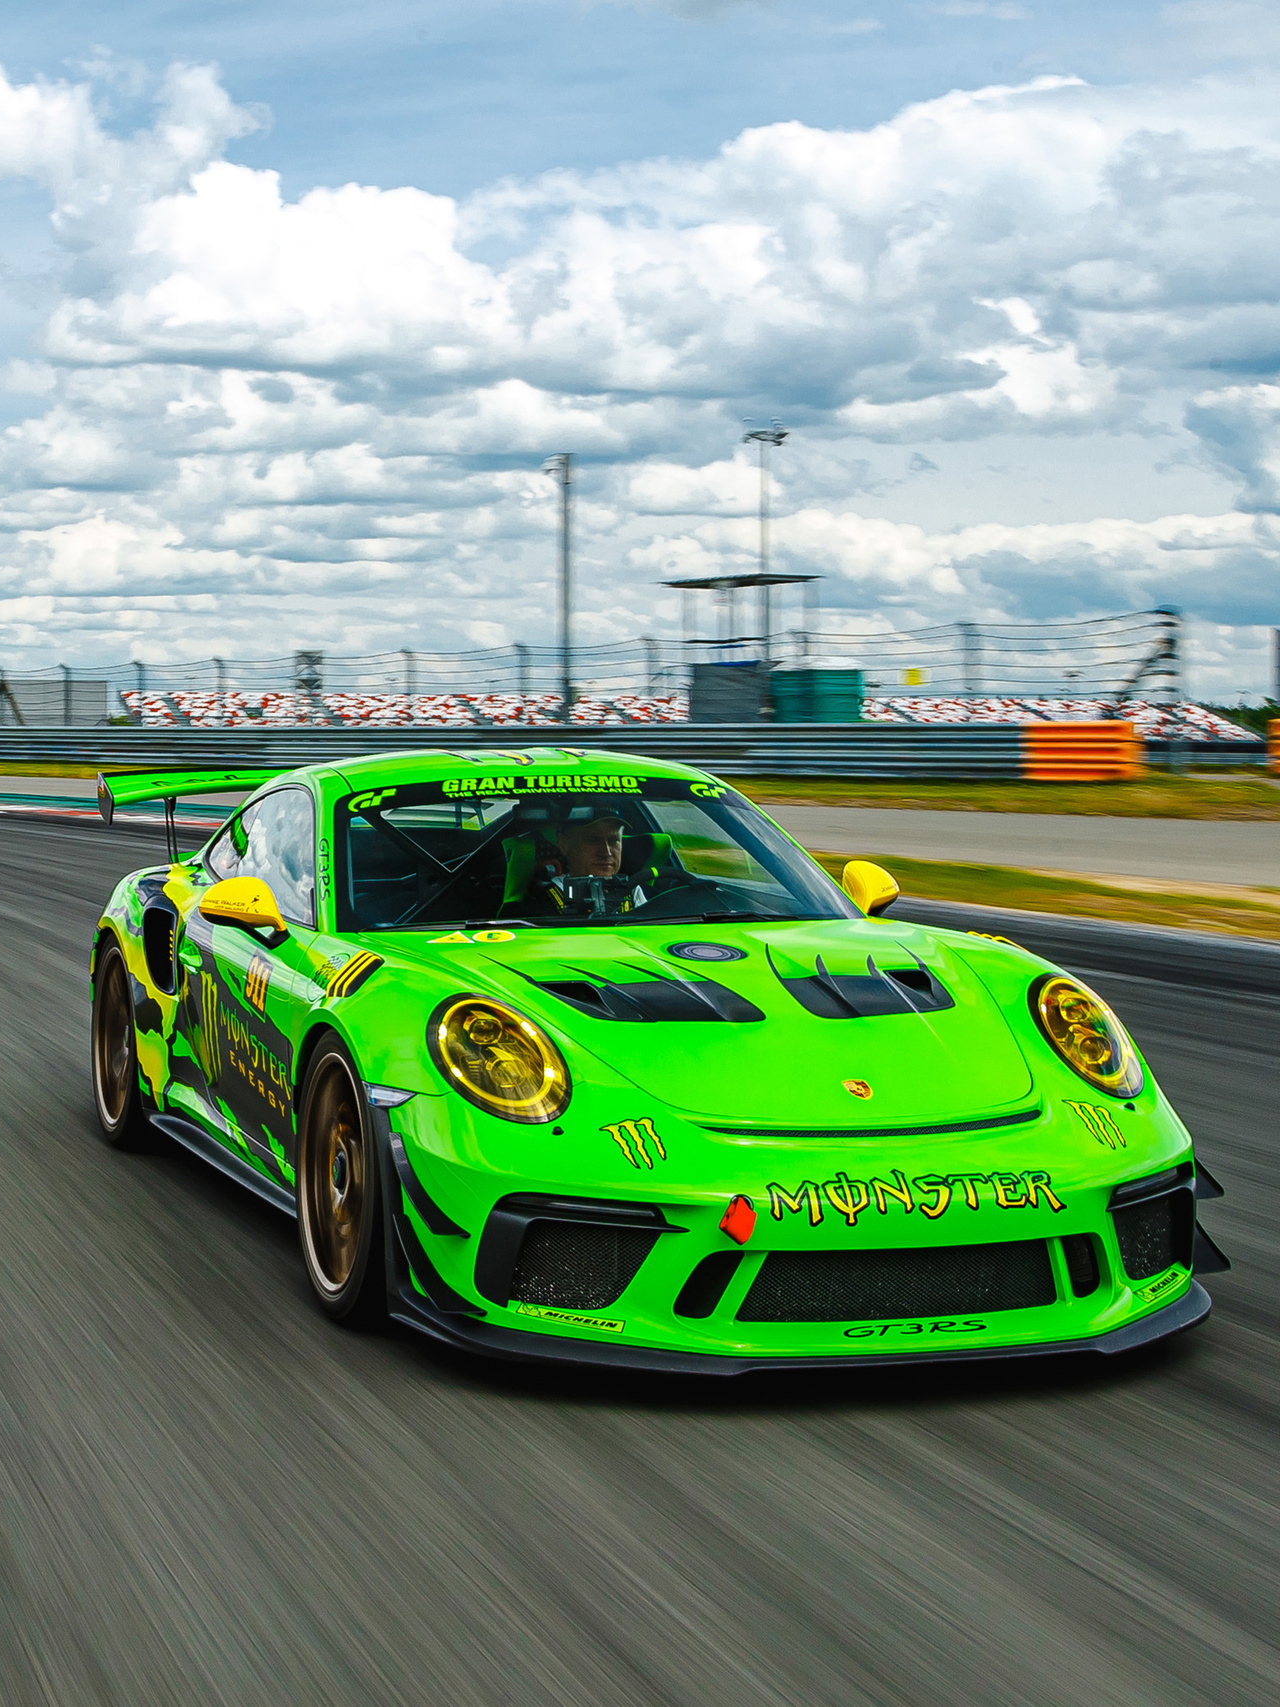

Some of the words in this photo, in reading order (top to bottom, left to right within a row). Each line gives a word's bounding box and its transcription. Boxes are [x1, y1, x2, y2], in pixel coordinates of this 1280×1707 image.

[442, 776, 515, 792] GRAN
[245, 956, 270, 1012] 911
[220, 1001, 291, 1101] MONSTER
[230, 1050, 286, 1117] ENERGY
[766, 1169, 1068, 1227] MONSTER
[1148, 1271, 1180, 1294] MICHELIN
[544, 1311, 618, 1328] MICHELIN
